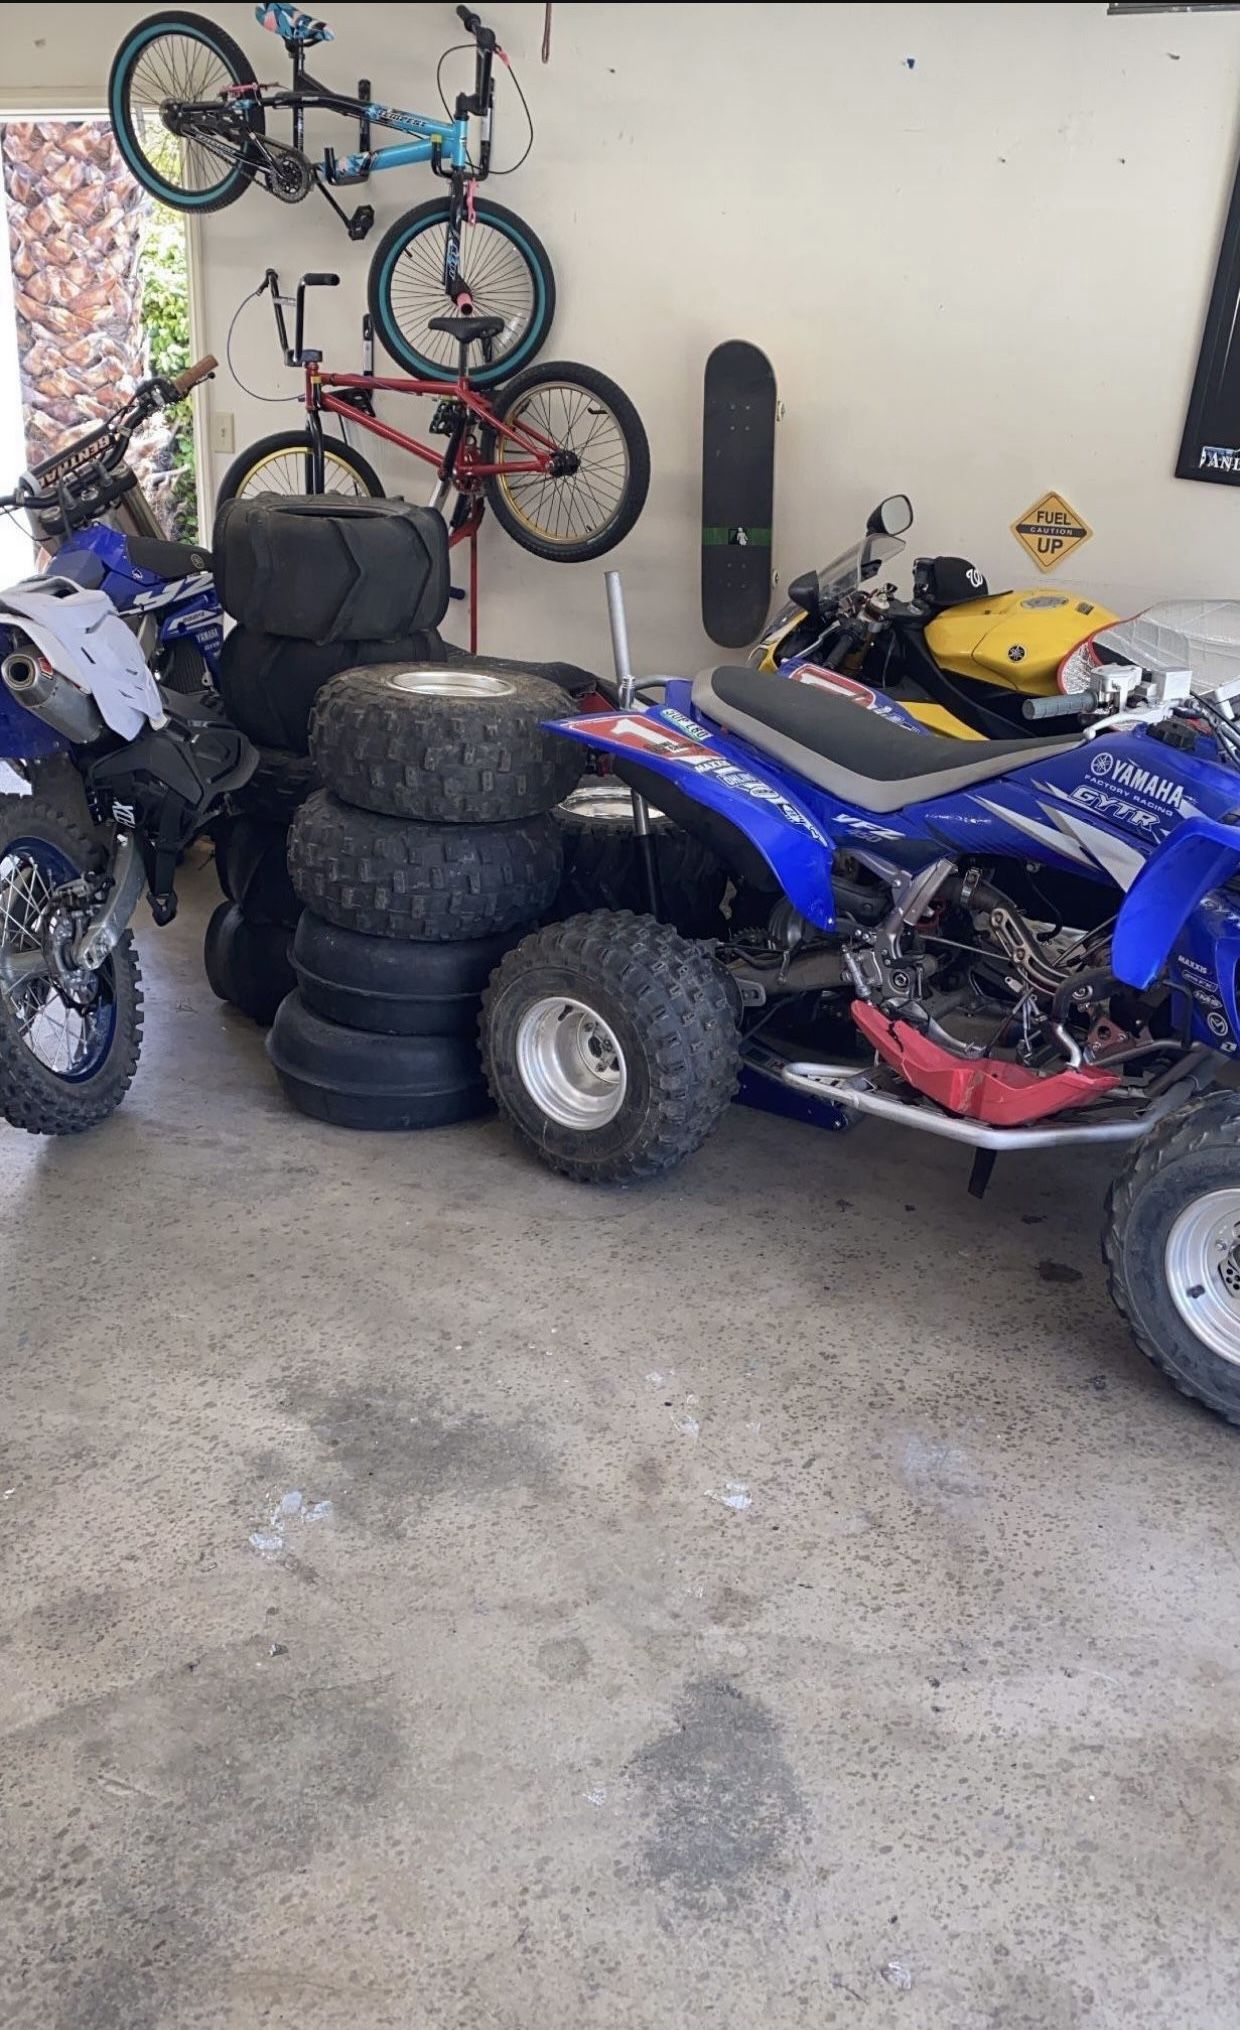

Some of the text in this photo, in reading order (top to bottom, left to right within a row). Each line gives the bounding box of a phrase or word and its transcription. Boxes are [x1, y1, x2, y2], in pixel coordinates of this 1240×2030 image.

[1030, 527, 1073, 536] CAUTION
[1037, 511, 1072, 525] FUEL
[1037, 538, 1063, 554] UP
[1084, 774, 1174, 817] FACTORY RACING
[1111, 759, 1185, 809] YAMAHA
[1070, 785, 1160, 831] GYTR
[832, 813, 906, 840] YFZ
